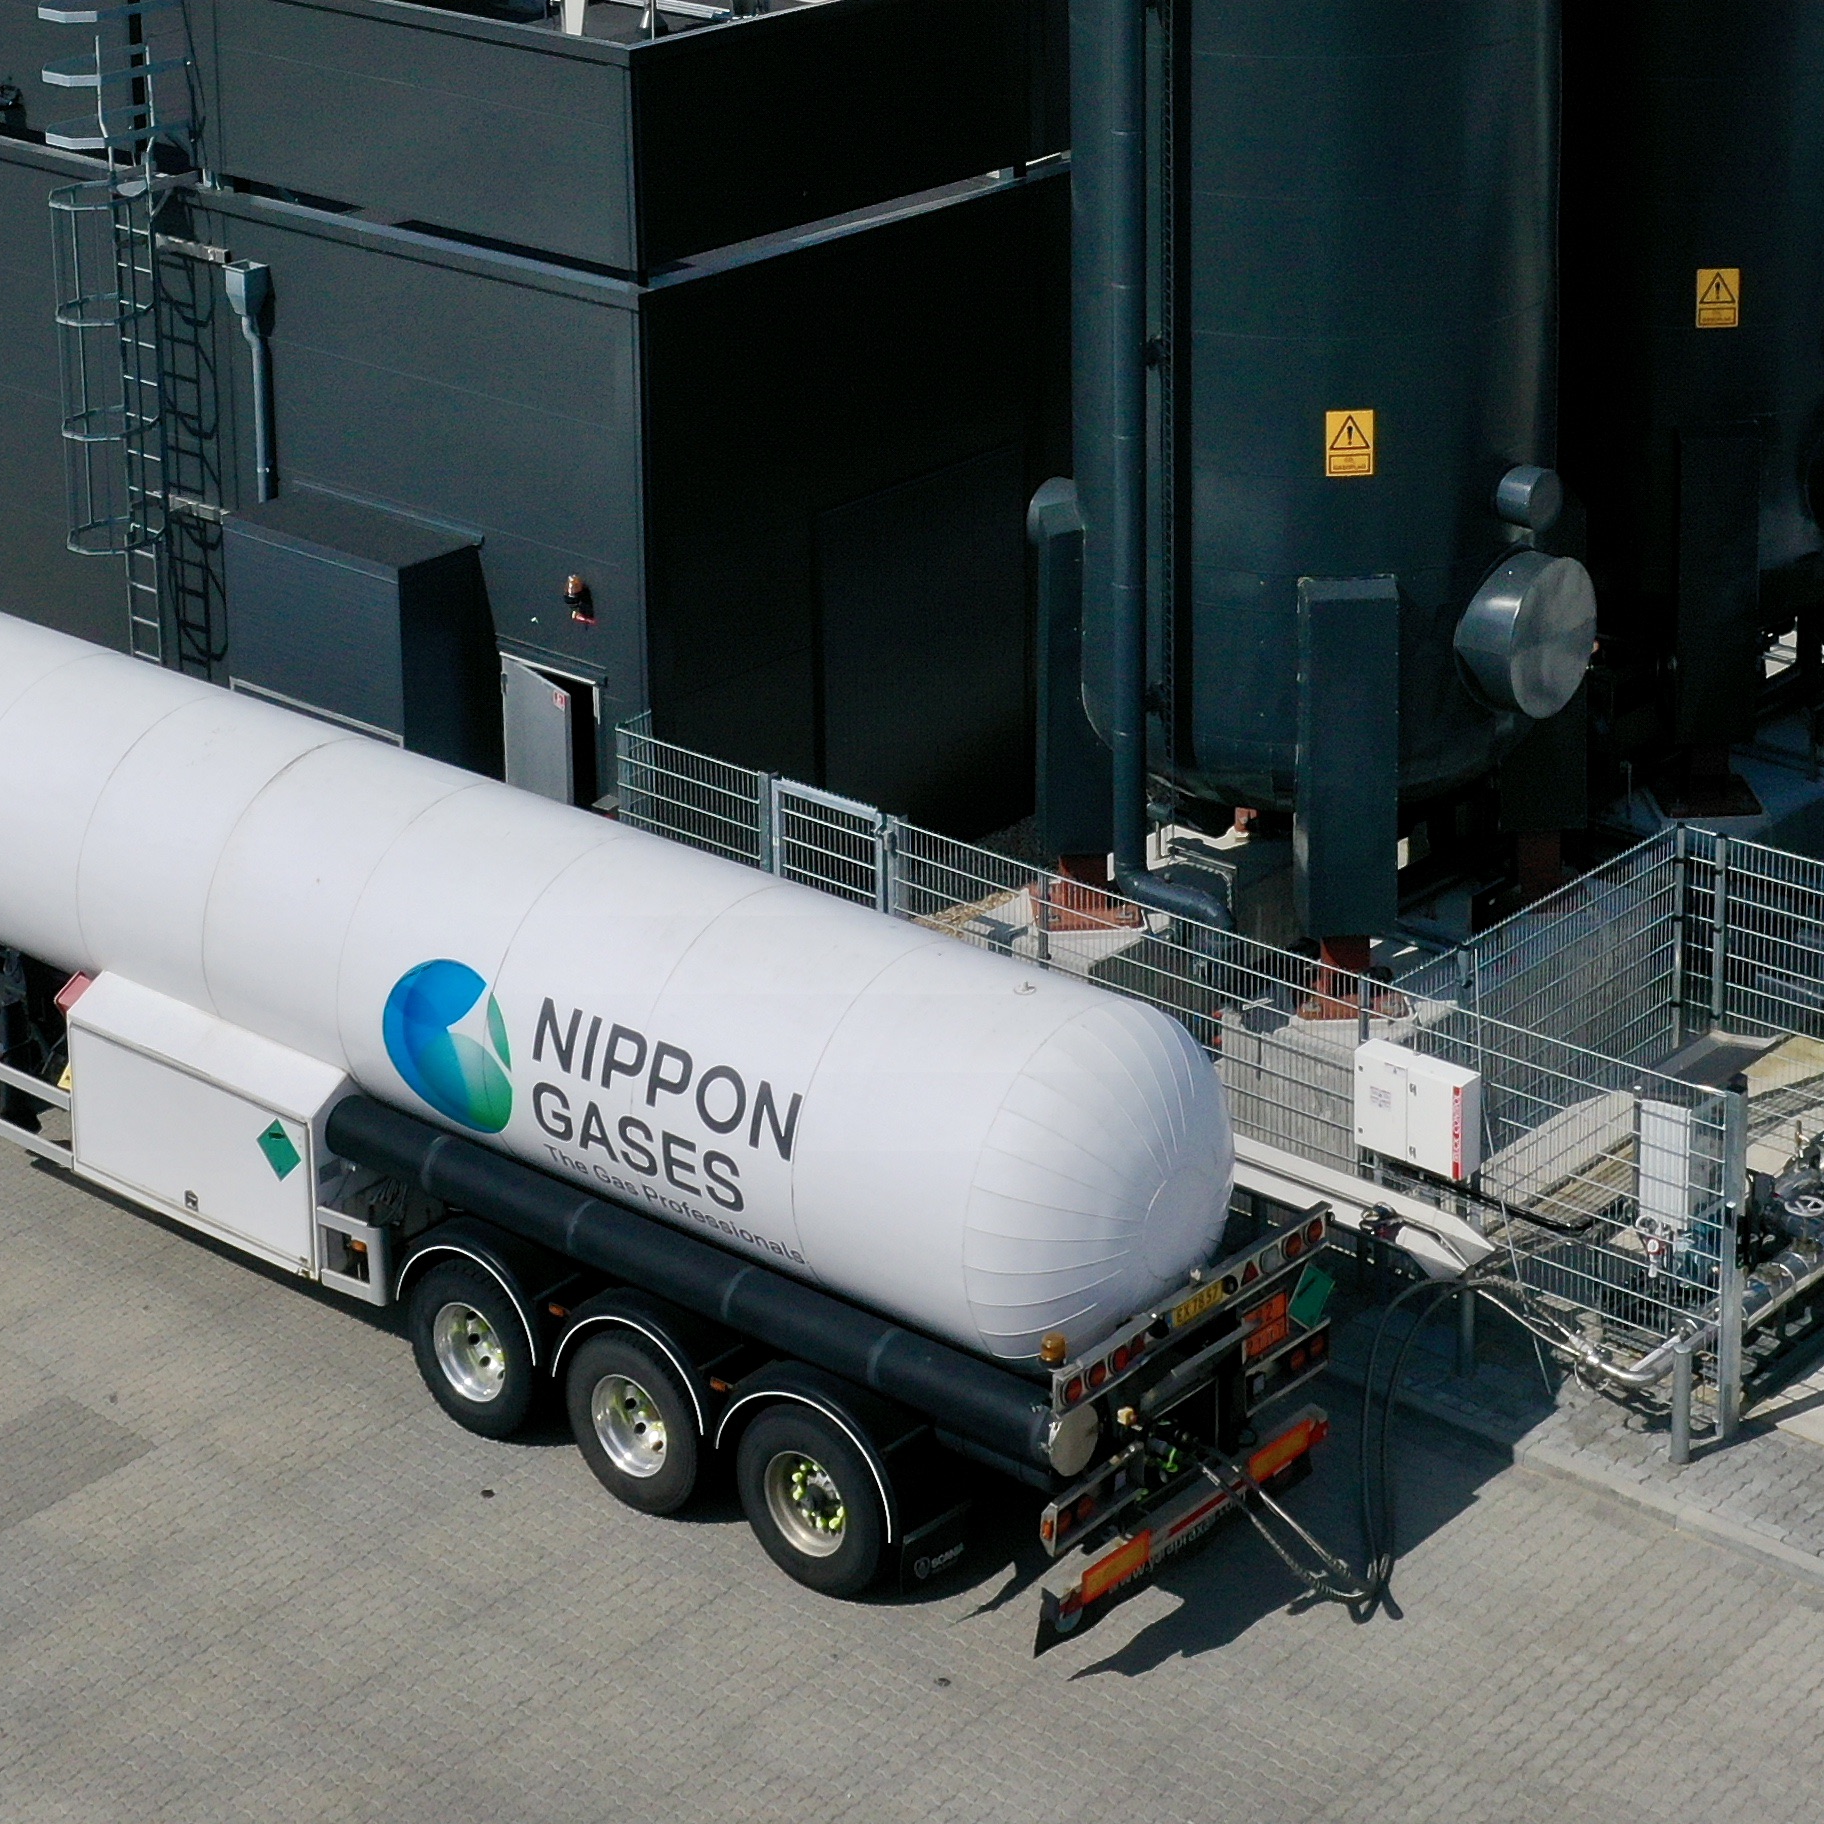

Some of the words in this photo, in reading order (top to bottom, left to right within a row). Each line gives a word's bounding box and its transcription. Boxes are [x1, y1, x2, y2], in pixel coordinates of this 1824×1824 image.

[532, 996, 803, 1162] NIPPON
[532, 1082, 745, 1213] GASES
[543, 1143, 589, 1175] The
[593, 1164, 639, 1196] Gas
[642, 1184, 806, 1265] Professionals
